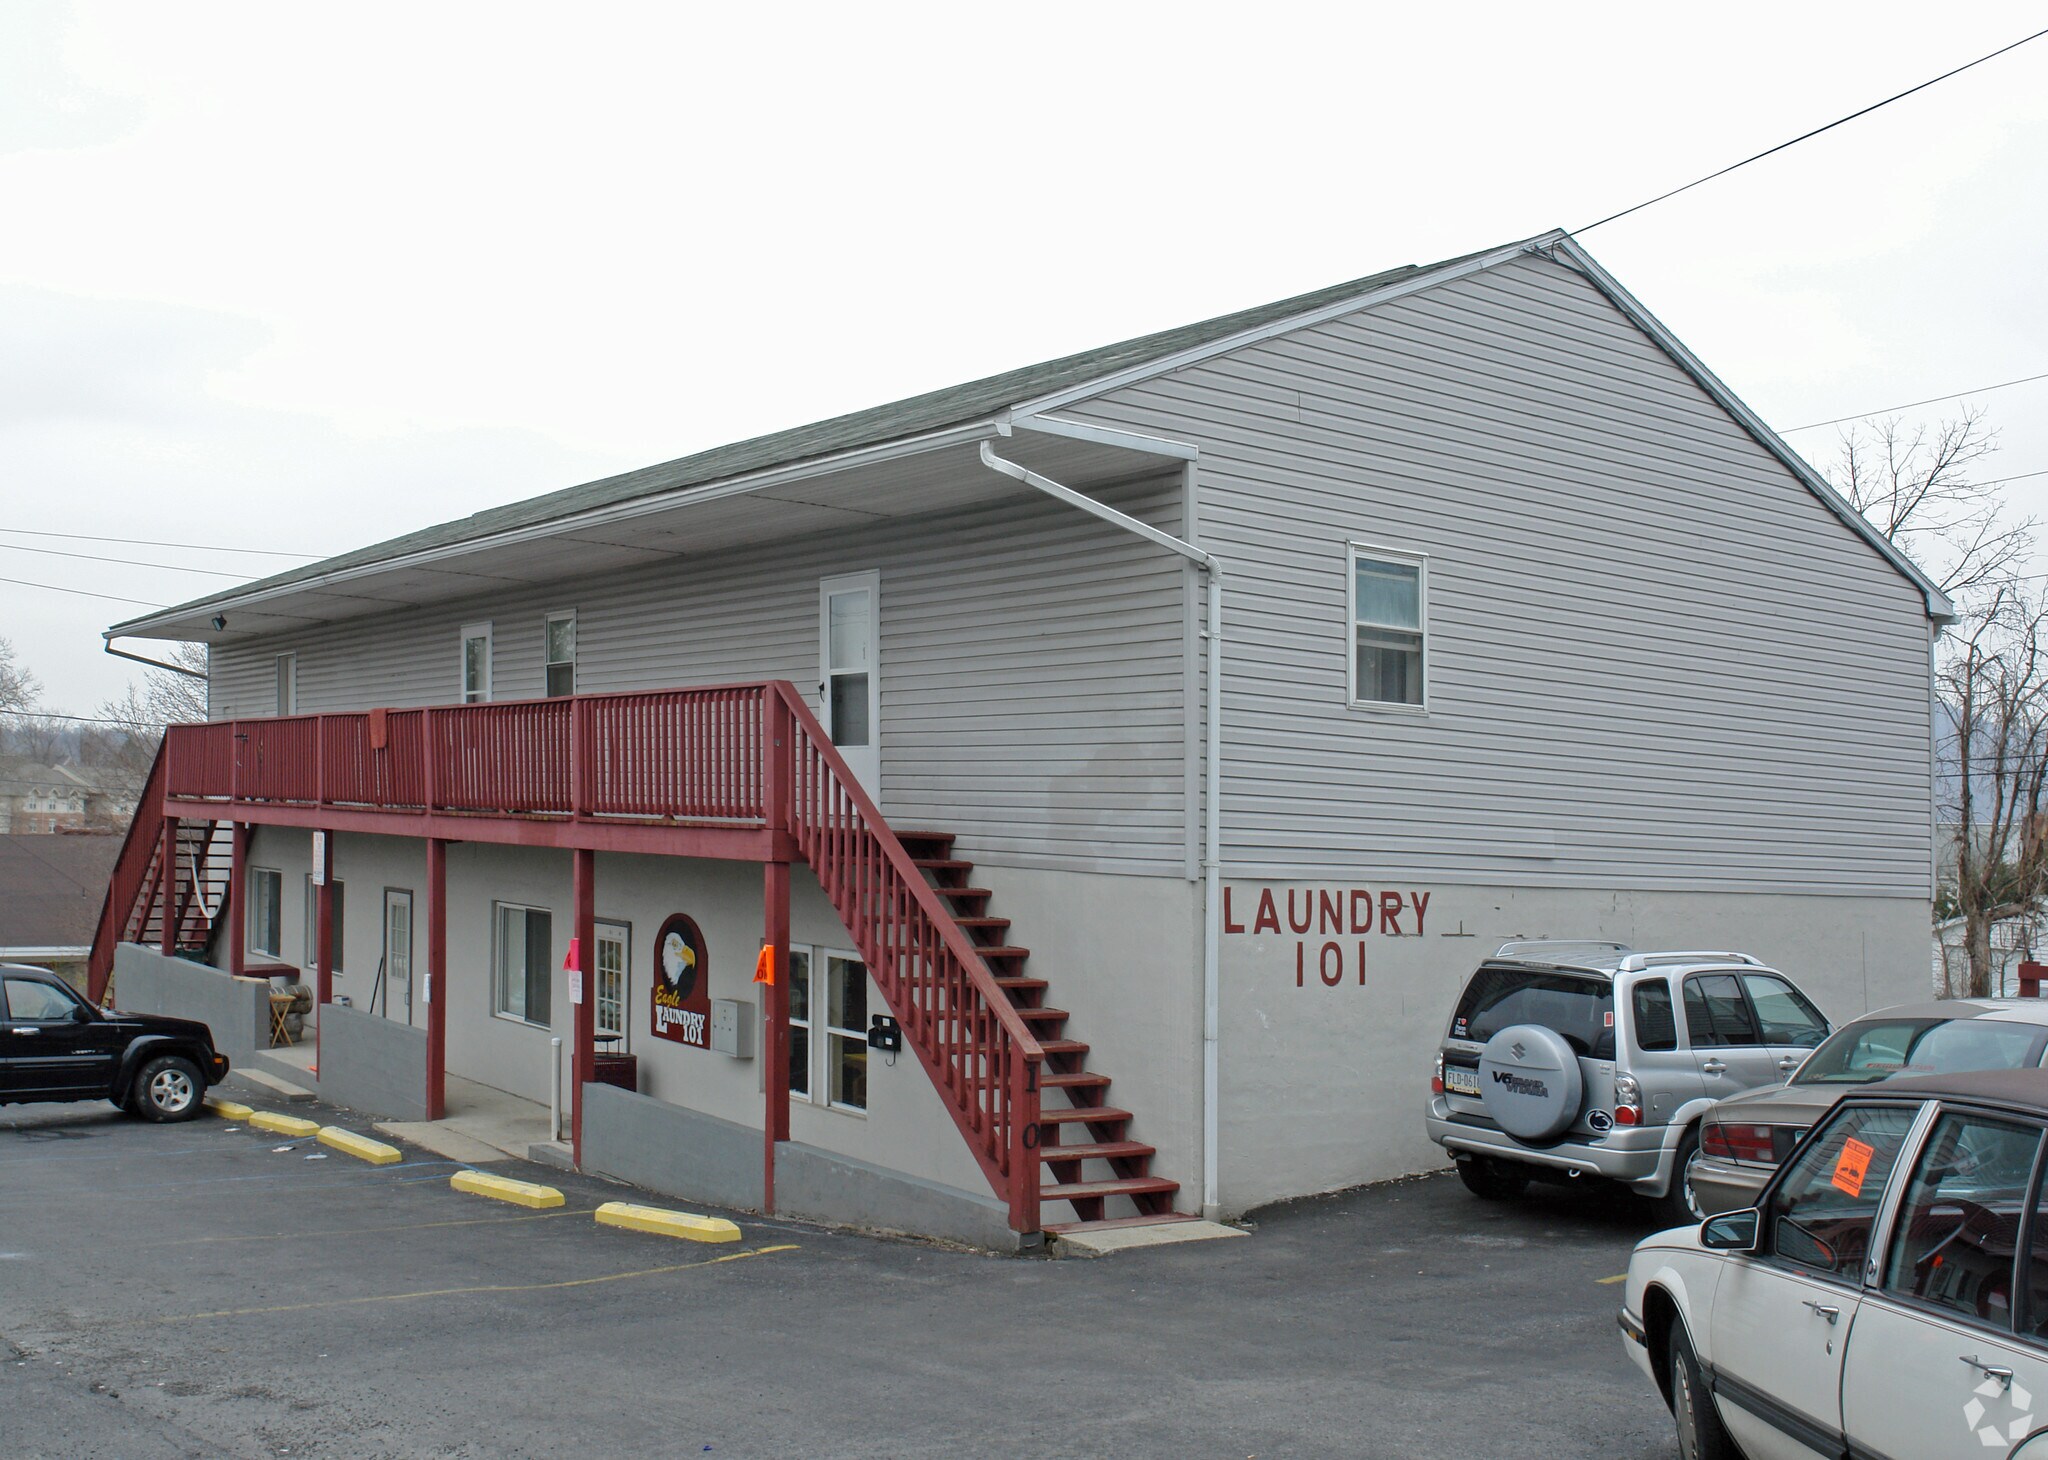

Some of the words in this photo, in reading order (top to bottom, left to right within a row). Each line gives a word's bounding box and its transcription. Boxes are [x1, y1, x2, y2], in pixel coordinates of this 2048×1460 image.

[1224, 886, 1431, 936] LAUNDRY
[1297, 941, 1365, 987] 101
[655, 985, 680, 1008] Eagle
[656, 1005, 705, 1033] LAUNDRY
[683, 1024, 703, 1045] 101
[1492, 1071, 1513, 1084] V6
